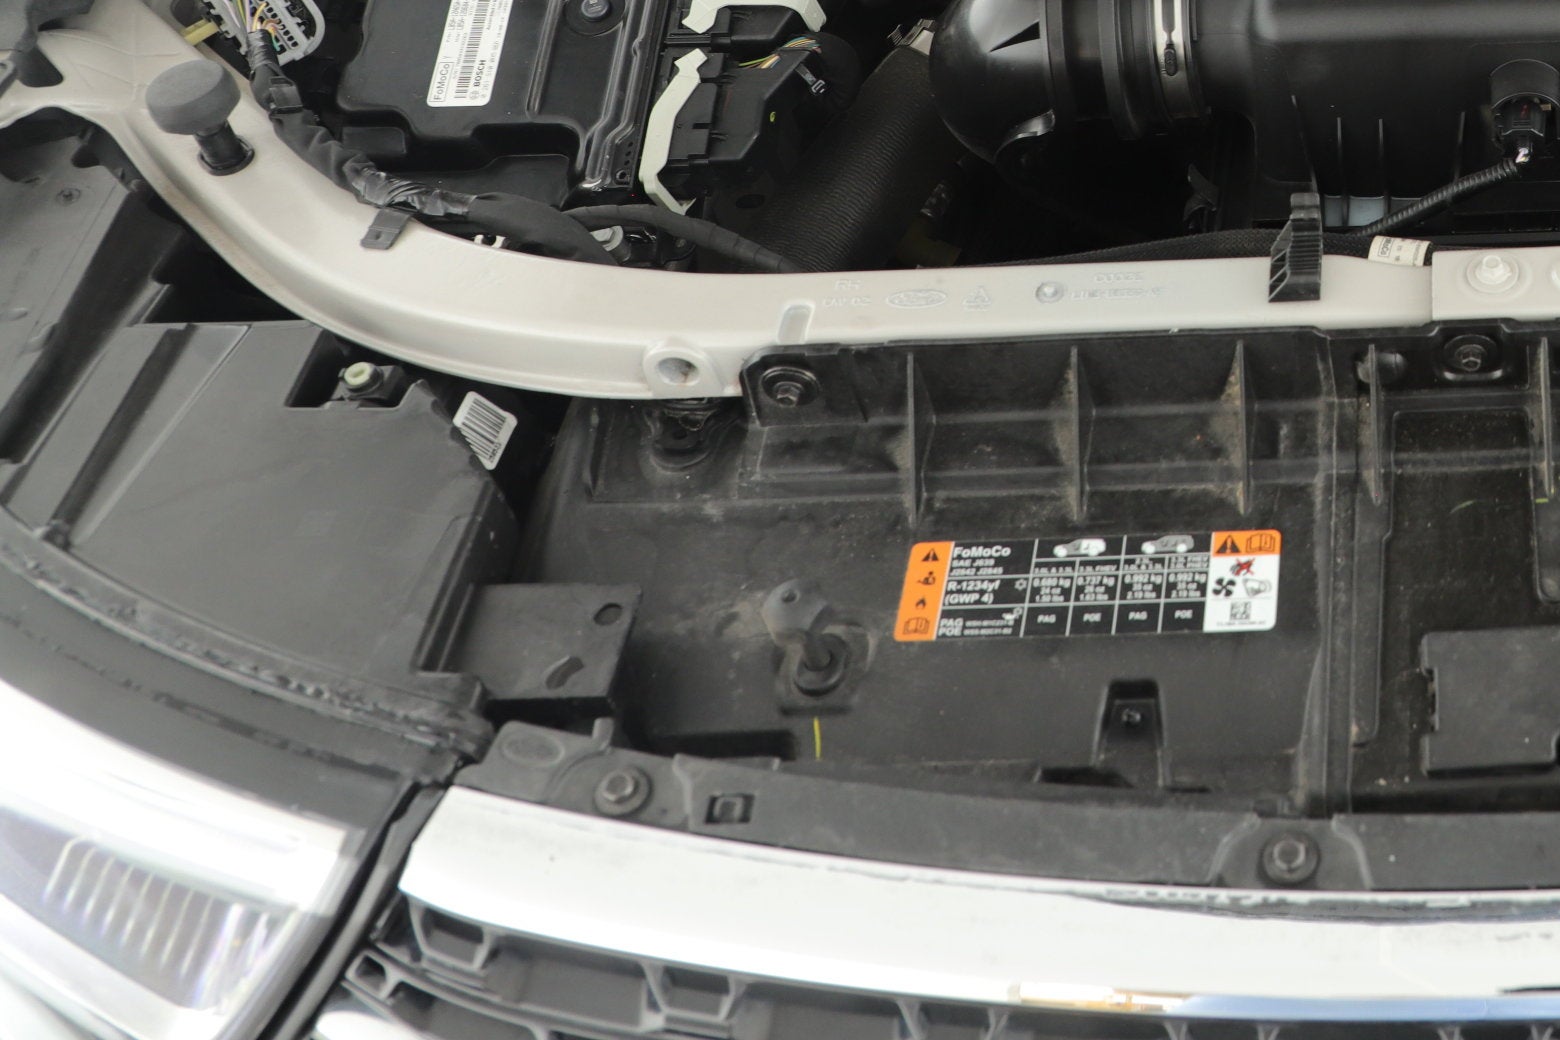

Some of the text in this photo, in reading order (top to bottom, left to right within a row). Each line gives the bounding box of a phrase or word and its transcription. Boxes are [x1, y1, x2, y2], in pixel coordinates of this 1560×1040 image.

[474, 60, 486, 87] BOSCH
[434, 64, 450, 100] FoMoCo
[953, 546, 1011, 558] FoMoCo
[952, 559, 972, 567] SAE
[1059, 578, 1072, 588] kg
[1077, 577, 1115, 587] 0.737 kg
[1124, 574, 1162, 585] 0.992 kg
[1168, 573, 1207, 584] 0.992 kg
[947, 580, 1000, 592] R-1234yf
[945, 593, 994, 606] (GWP 4)
[1037, 614, 1056, 623] PAG
[1083, 613, 1102, 622] POE
[1128, 611, 1148, 620] PAG
[1175, 610, 1193, 619] POE
[940, 618, 964, 627] PAG
[938, 627, 962, 636] POE
